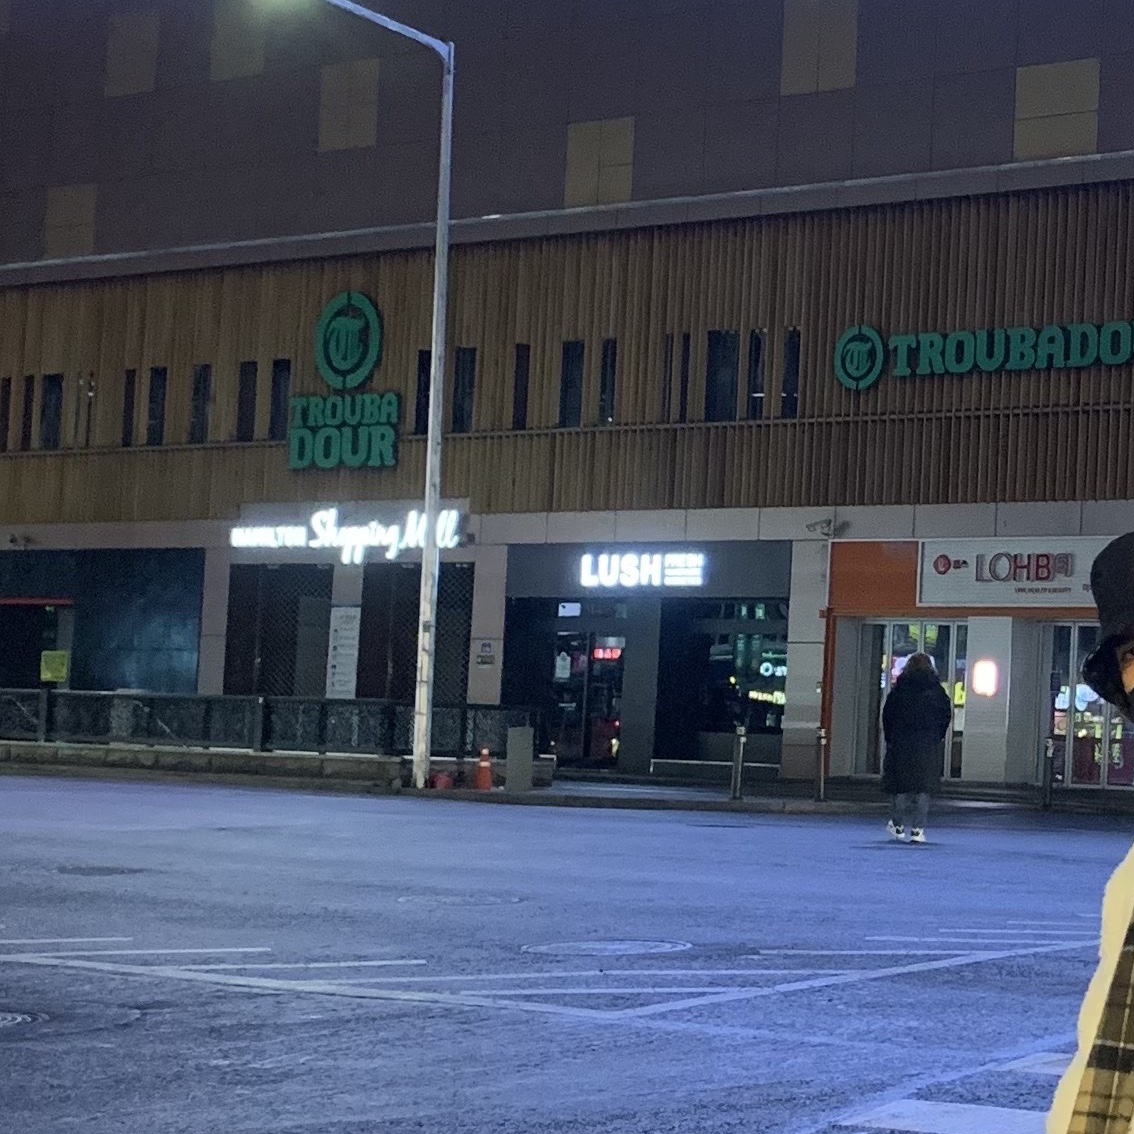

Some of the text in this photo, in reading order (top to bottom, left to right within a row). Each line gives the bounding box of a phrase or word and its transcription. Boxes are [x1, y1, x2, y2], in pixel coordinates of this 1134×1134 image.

[290, 392, 398, 428] TROUBA
[289, 424, 396, 470] DOUR
[309, 508, 399, 565] Shopping
[400, 509, 460, 549] Mll
[580, 553, 662, 588] LUSH
